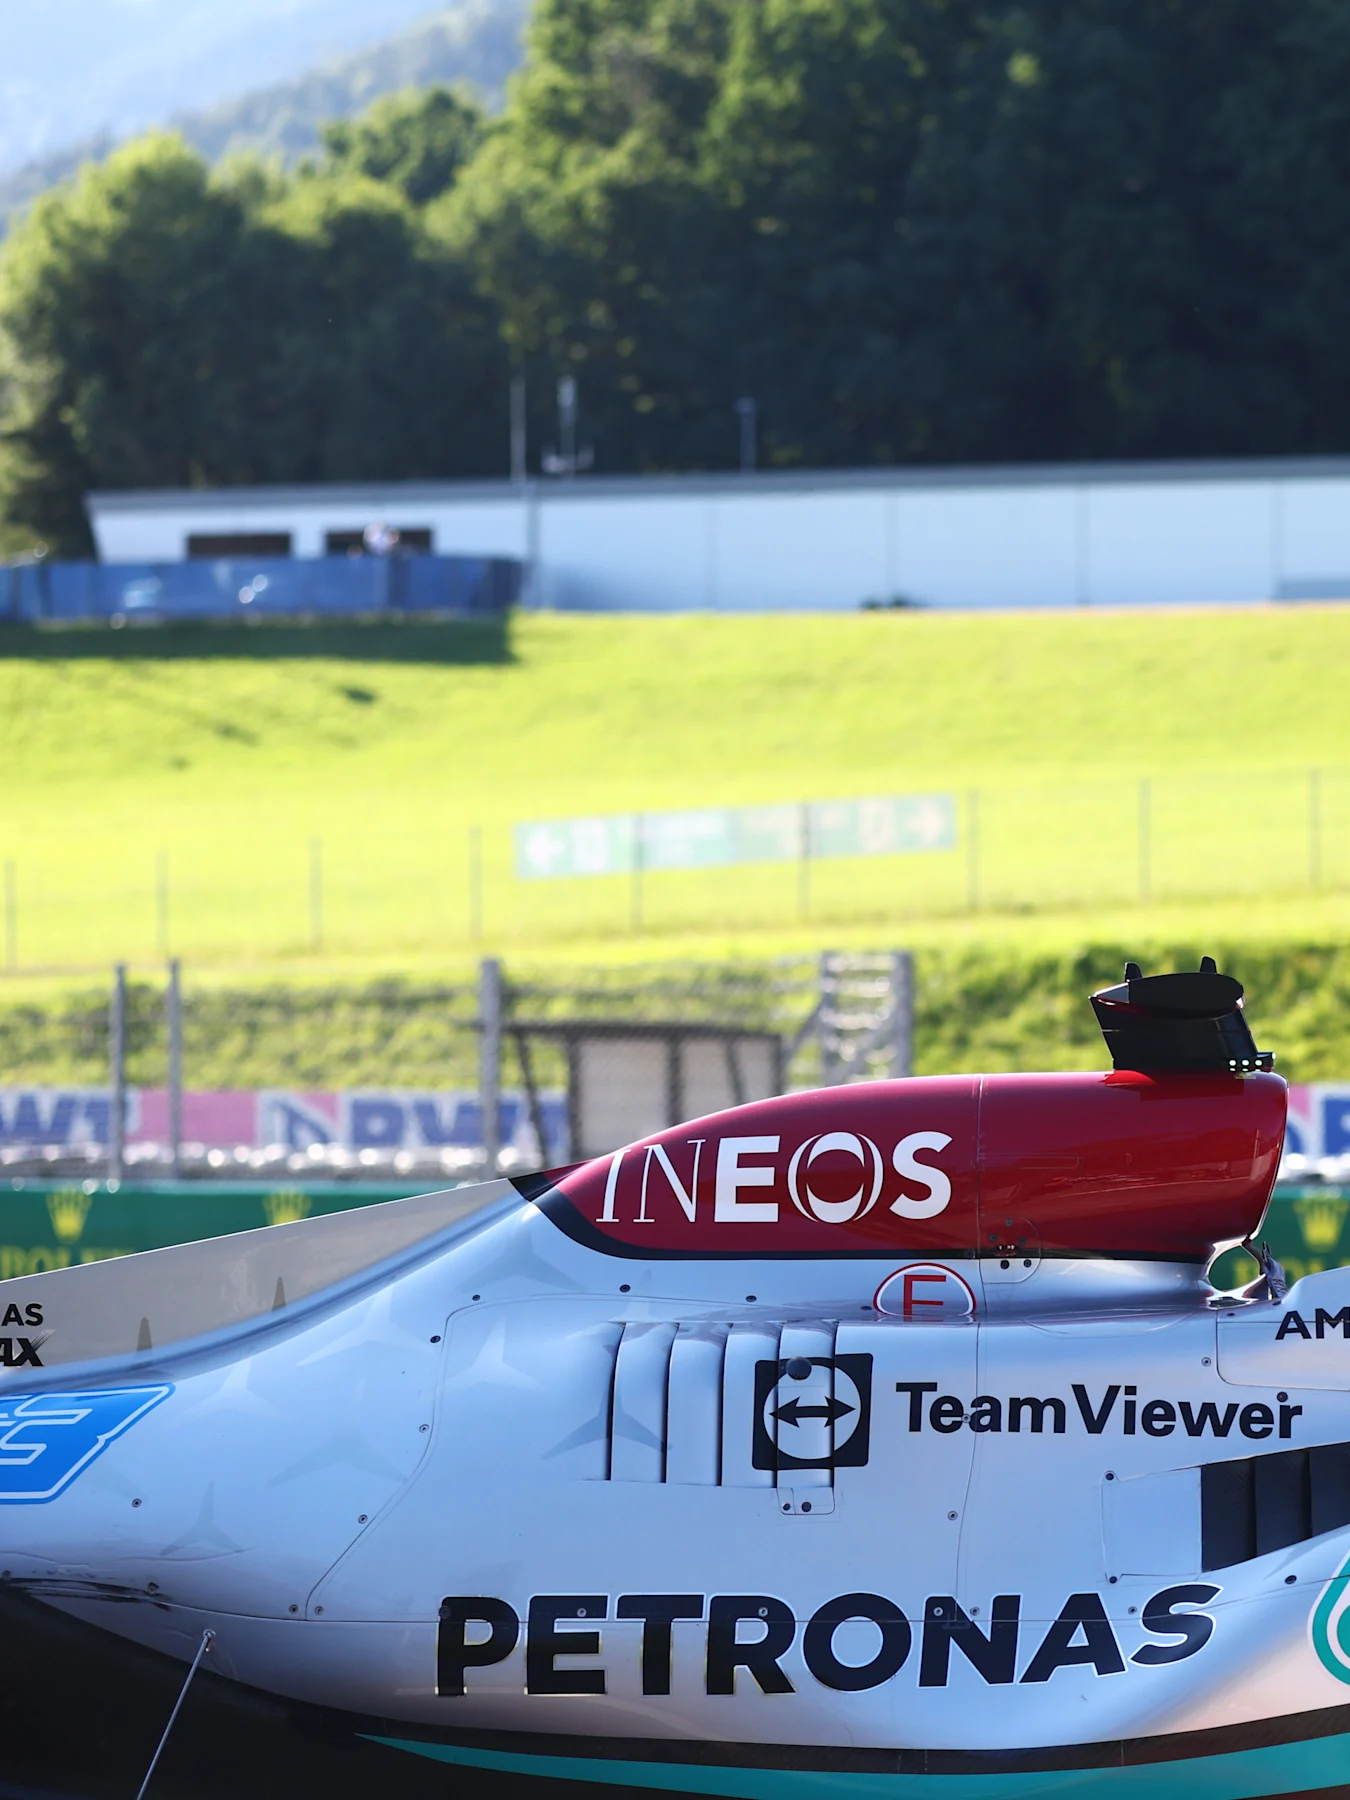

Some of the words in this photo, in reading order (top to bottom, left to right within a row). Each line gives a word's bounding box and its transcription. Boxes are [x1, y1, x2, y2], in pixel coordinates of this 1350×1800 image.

[596, 1131, 953, 1224] INEOS
[895, 1381, 1303, 1440] TeamViewer
[434, 1581, 1223, 1699] PETRONAS
